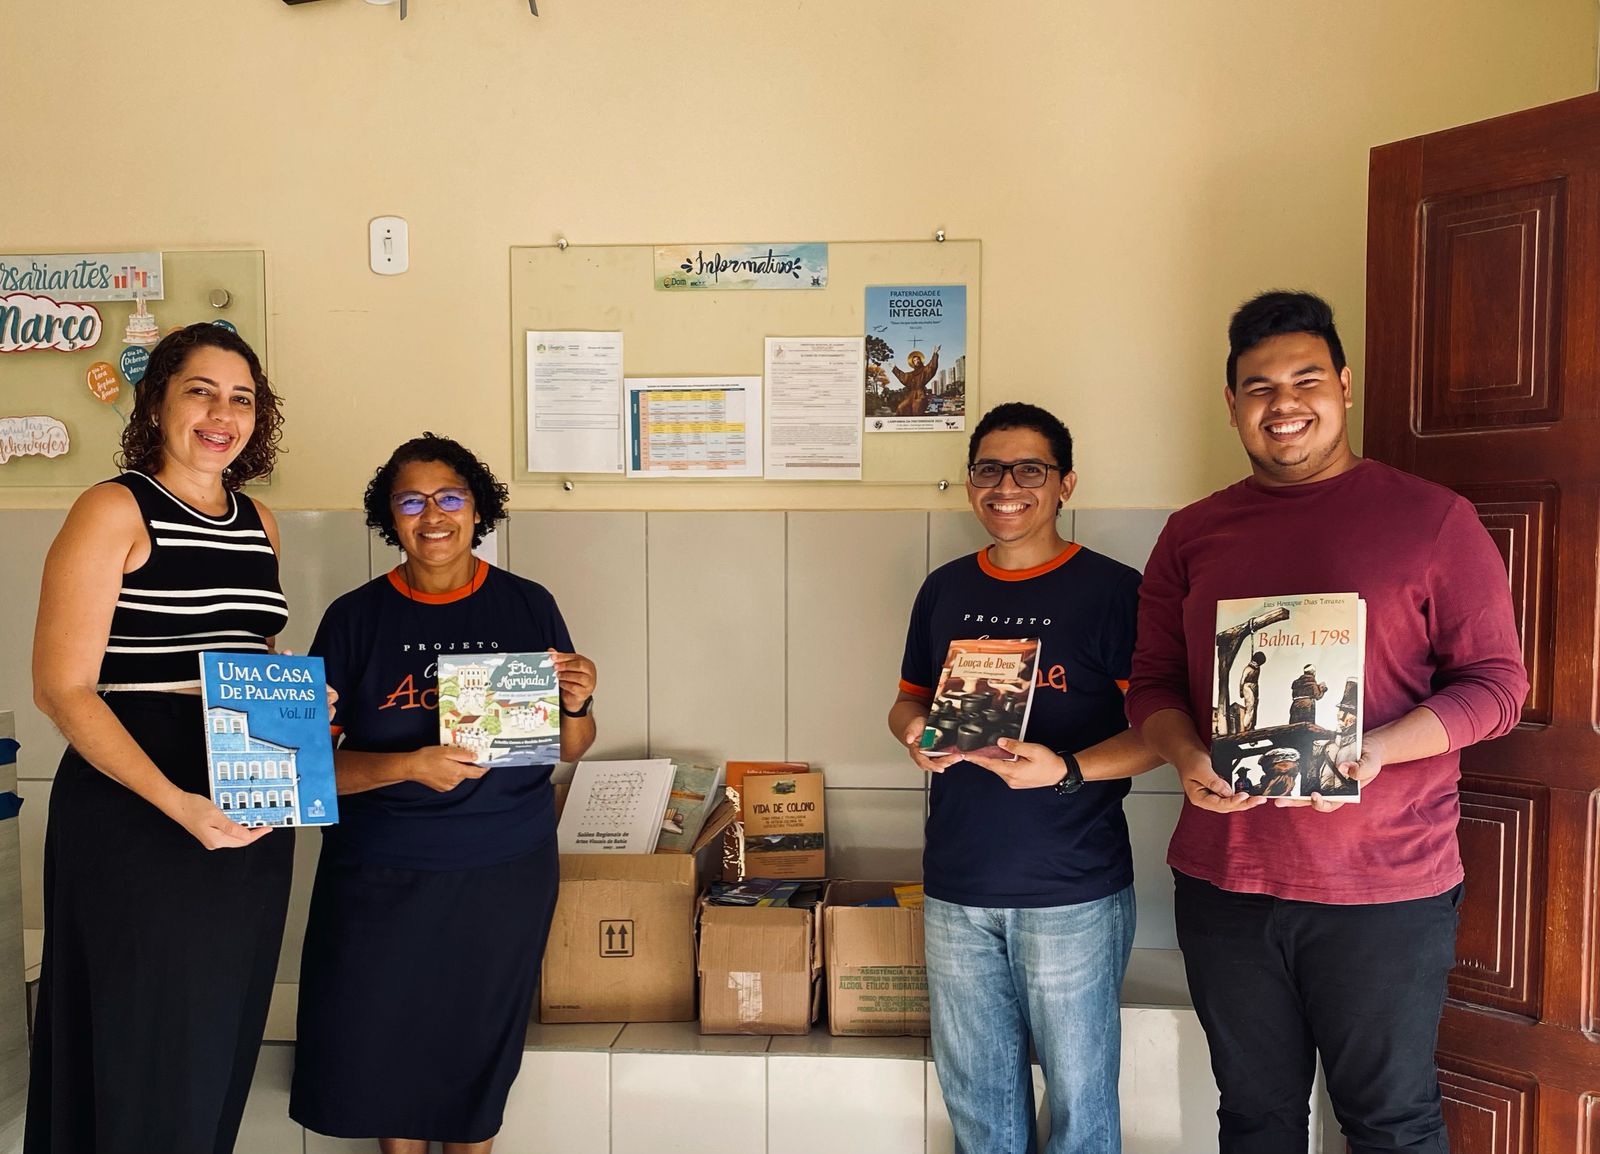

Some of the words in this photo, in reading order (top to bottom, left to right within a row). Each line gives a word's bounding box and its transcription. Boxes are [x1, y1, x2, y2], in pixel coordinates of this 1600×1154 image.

[695, 249, 793, 283] Informativo
[889, 299, 943, 308] ECOLOGIA
[889, 308, 943, 318] INTEGRAL
[964, 614, 1051, 626] PROJETO
[1259, 629, 1304, 648] Bahia,
[1310, 629, 1350, 646] 1798
[404, 641, 499, 651] PROJETO
[958, 657, 981, 669] Louça
[984, 658, 993, 668] de
[995, 658, 1016, 669] Deus
[218, 662, 262, 682] UMA
[266, 664, 313, 683] CASA
[220, 684, 242, 700] DE
[246, 685, 315, 701] PALAVRAS
[279, 707, 301, 720] Vol.
[304, 707, 316, 720] III
[753, 804, 770, 814] VIDA
[773, 803, 783, 813] DE
[787, 802, 815, 813] COLONO
